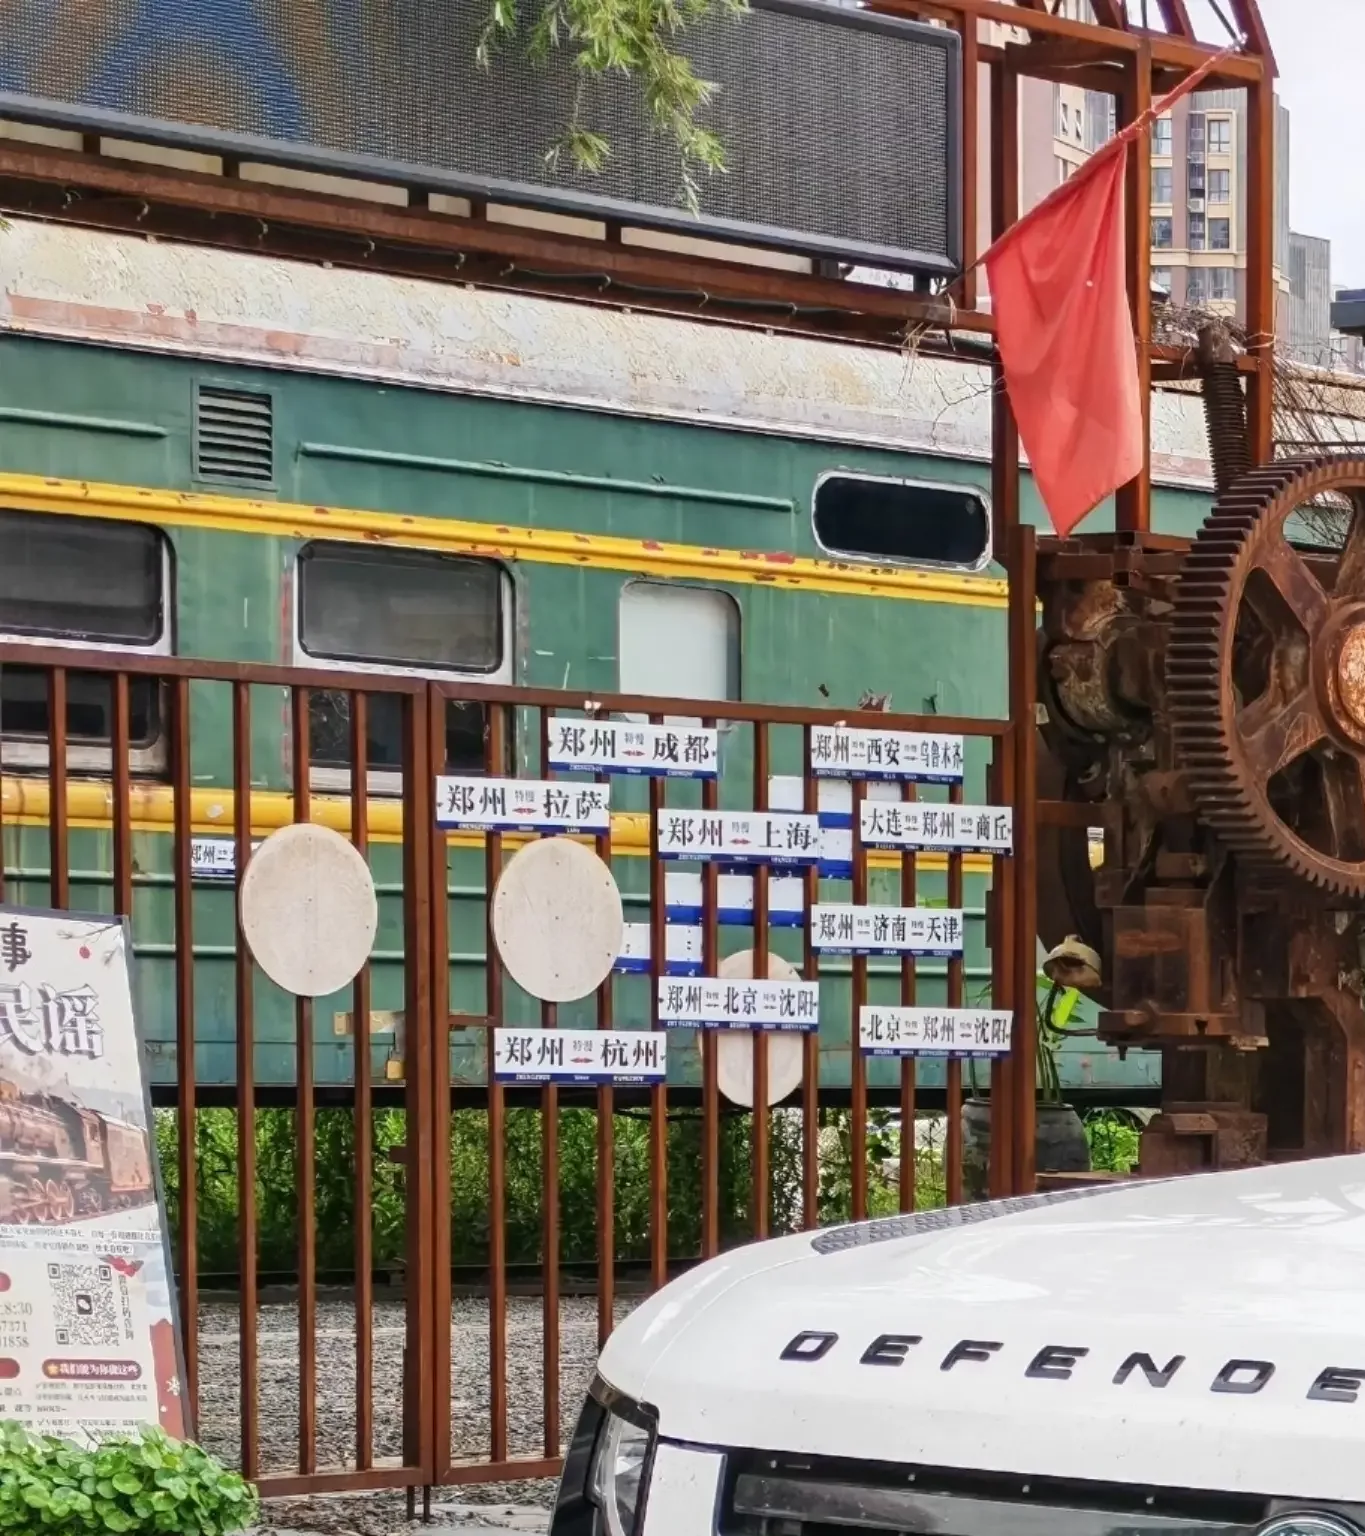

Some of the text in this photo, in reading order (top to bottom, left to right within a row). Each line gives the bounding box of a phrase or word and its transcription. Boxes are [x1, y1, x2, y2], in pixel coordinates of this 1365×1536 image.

[559, 726, 617, 758] 郑州
[653, 732, 710, 764] 成都
[867, 737, 901, 766] 西安
[447, 785, 506, 817] 郑州
[543, 788, 603, 820] 拉萨
[667, 816, 723, 848] 郑州
[758, 820, 813, 851] 上海
[868, 807, 902, 837] 大连
[922, 810, 955, 840] 郑州
[819, 912, 854, 942] 郑州
[926, 915, 960, 944] 天津
[666, 984, 702, 1014] 郑州
[723, 986, 758, 1016] 北京
[868, 1014, 901, 1043] 北京
[922, 1015, 955, 1044] 郑州
[505, 1036, 564, 1067] 郑州
[600, 1038, 658, 1069] 杭州
[0, 1301, 33, 1316] 8:30
